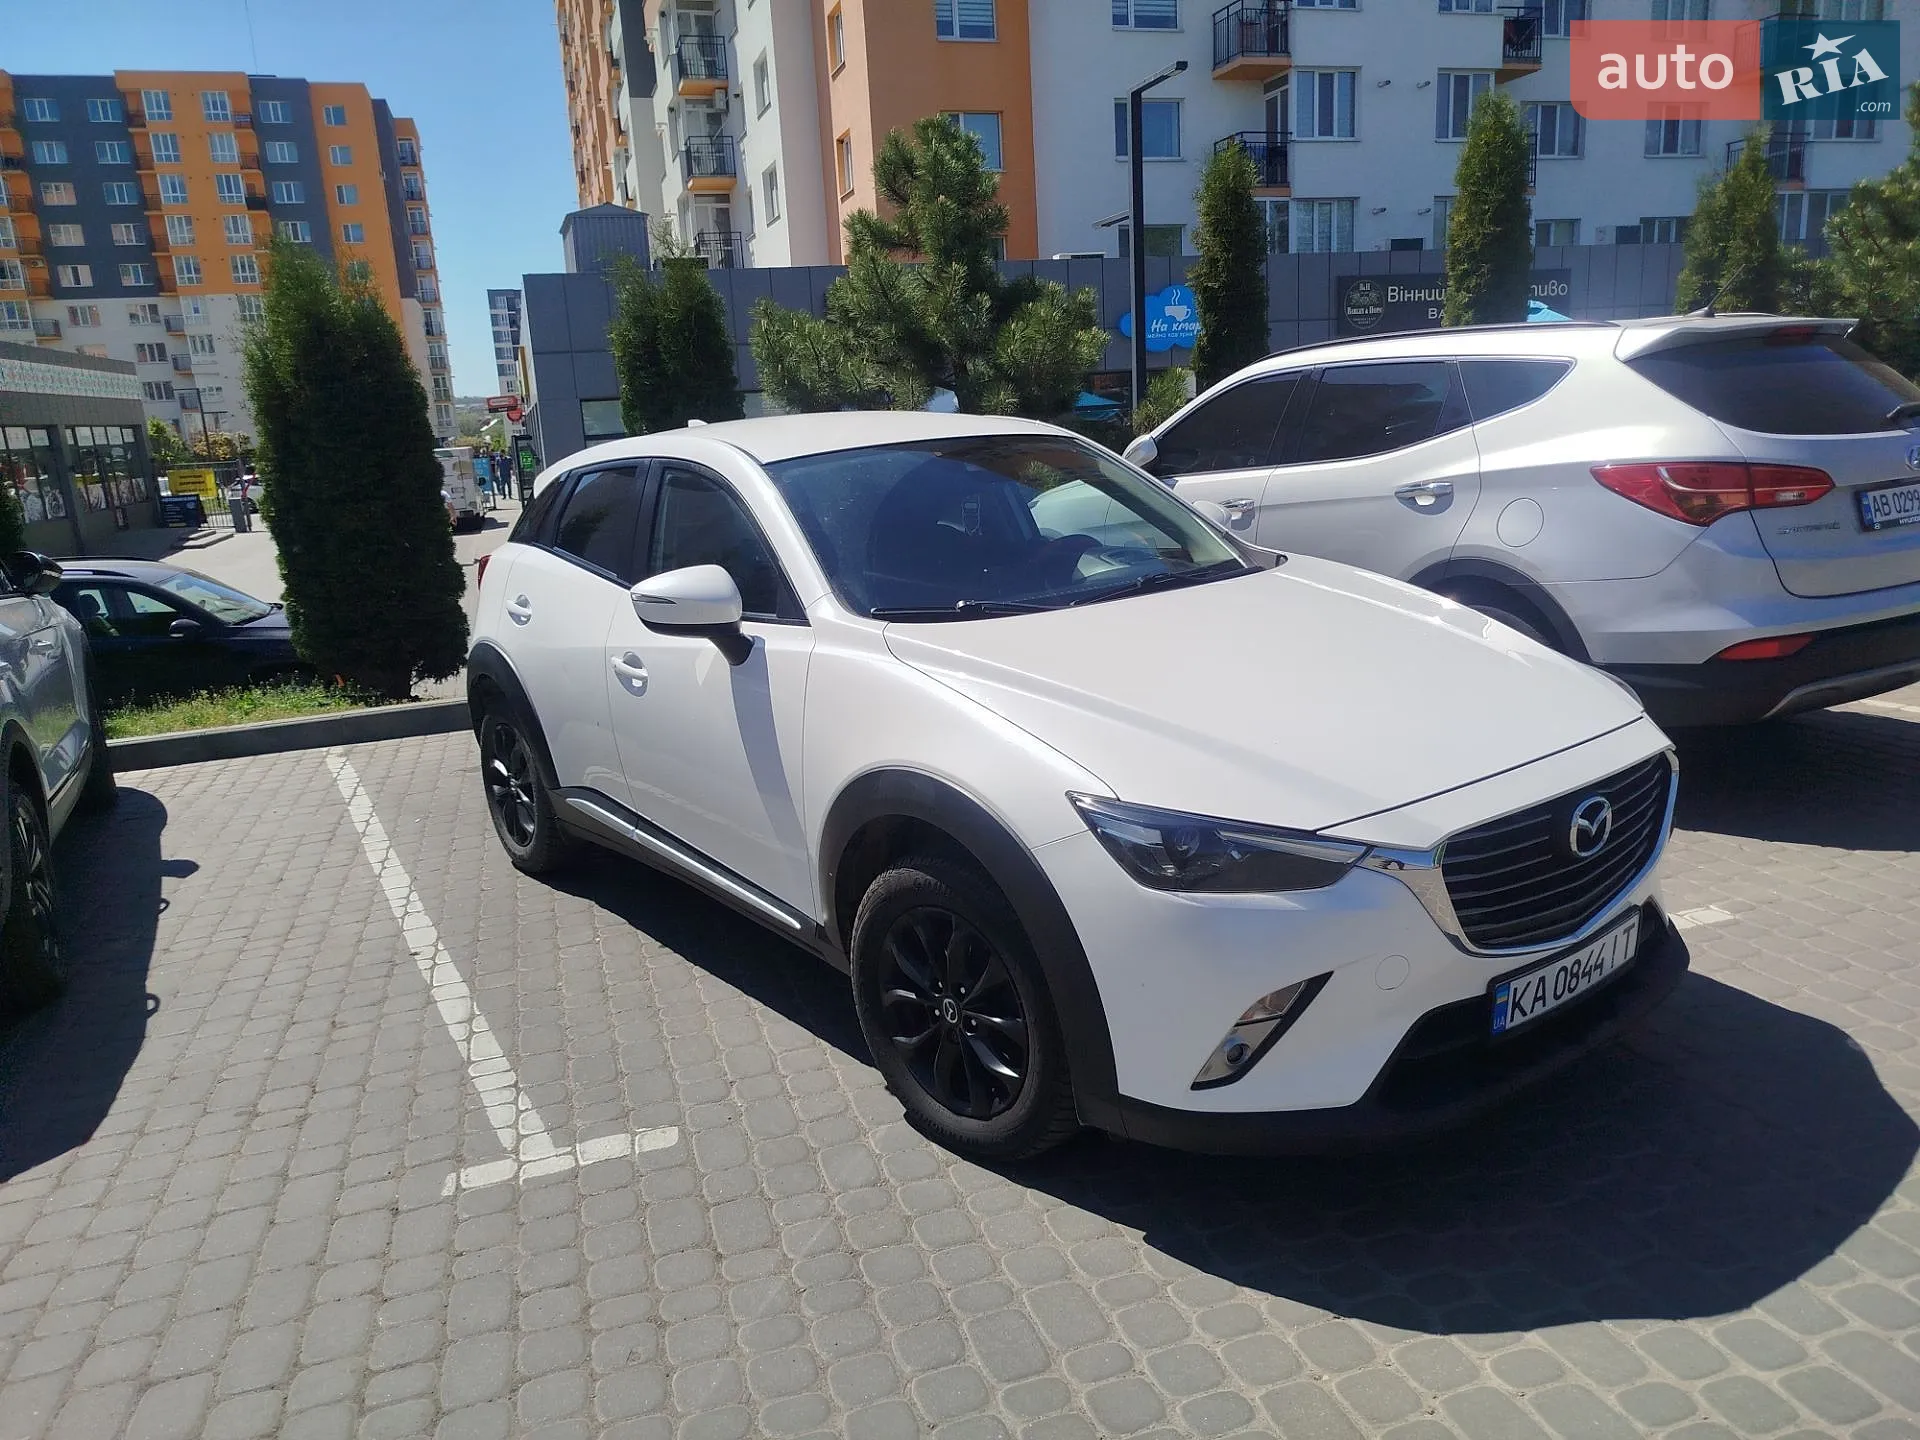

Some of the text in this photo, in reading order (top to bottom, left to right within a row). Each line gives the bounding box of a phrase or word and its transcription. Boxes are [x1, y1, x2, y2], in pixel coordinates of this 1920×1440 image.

[1151, 319, 1200, 335] На хмар
[1872, 494, 1892, 518] AB
[1509, 923, 1635, 1023] KA 0844 IT
[1493, 1014, 1506, 1030] UA
